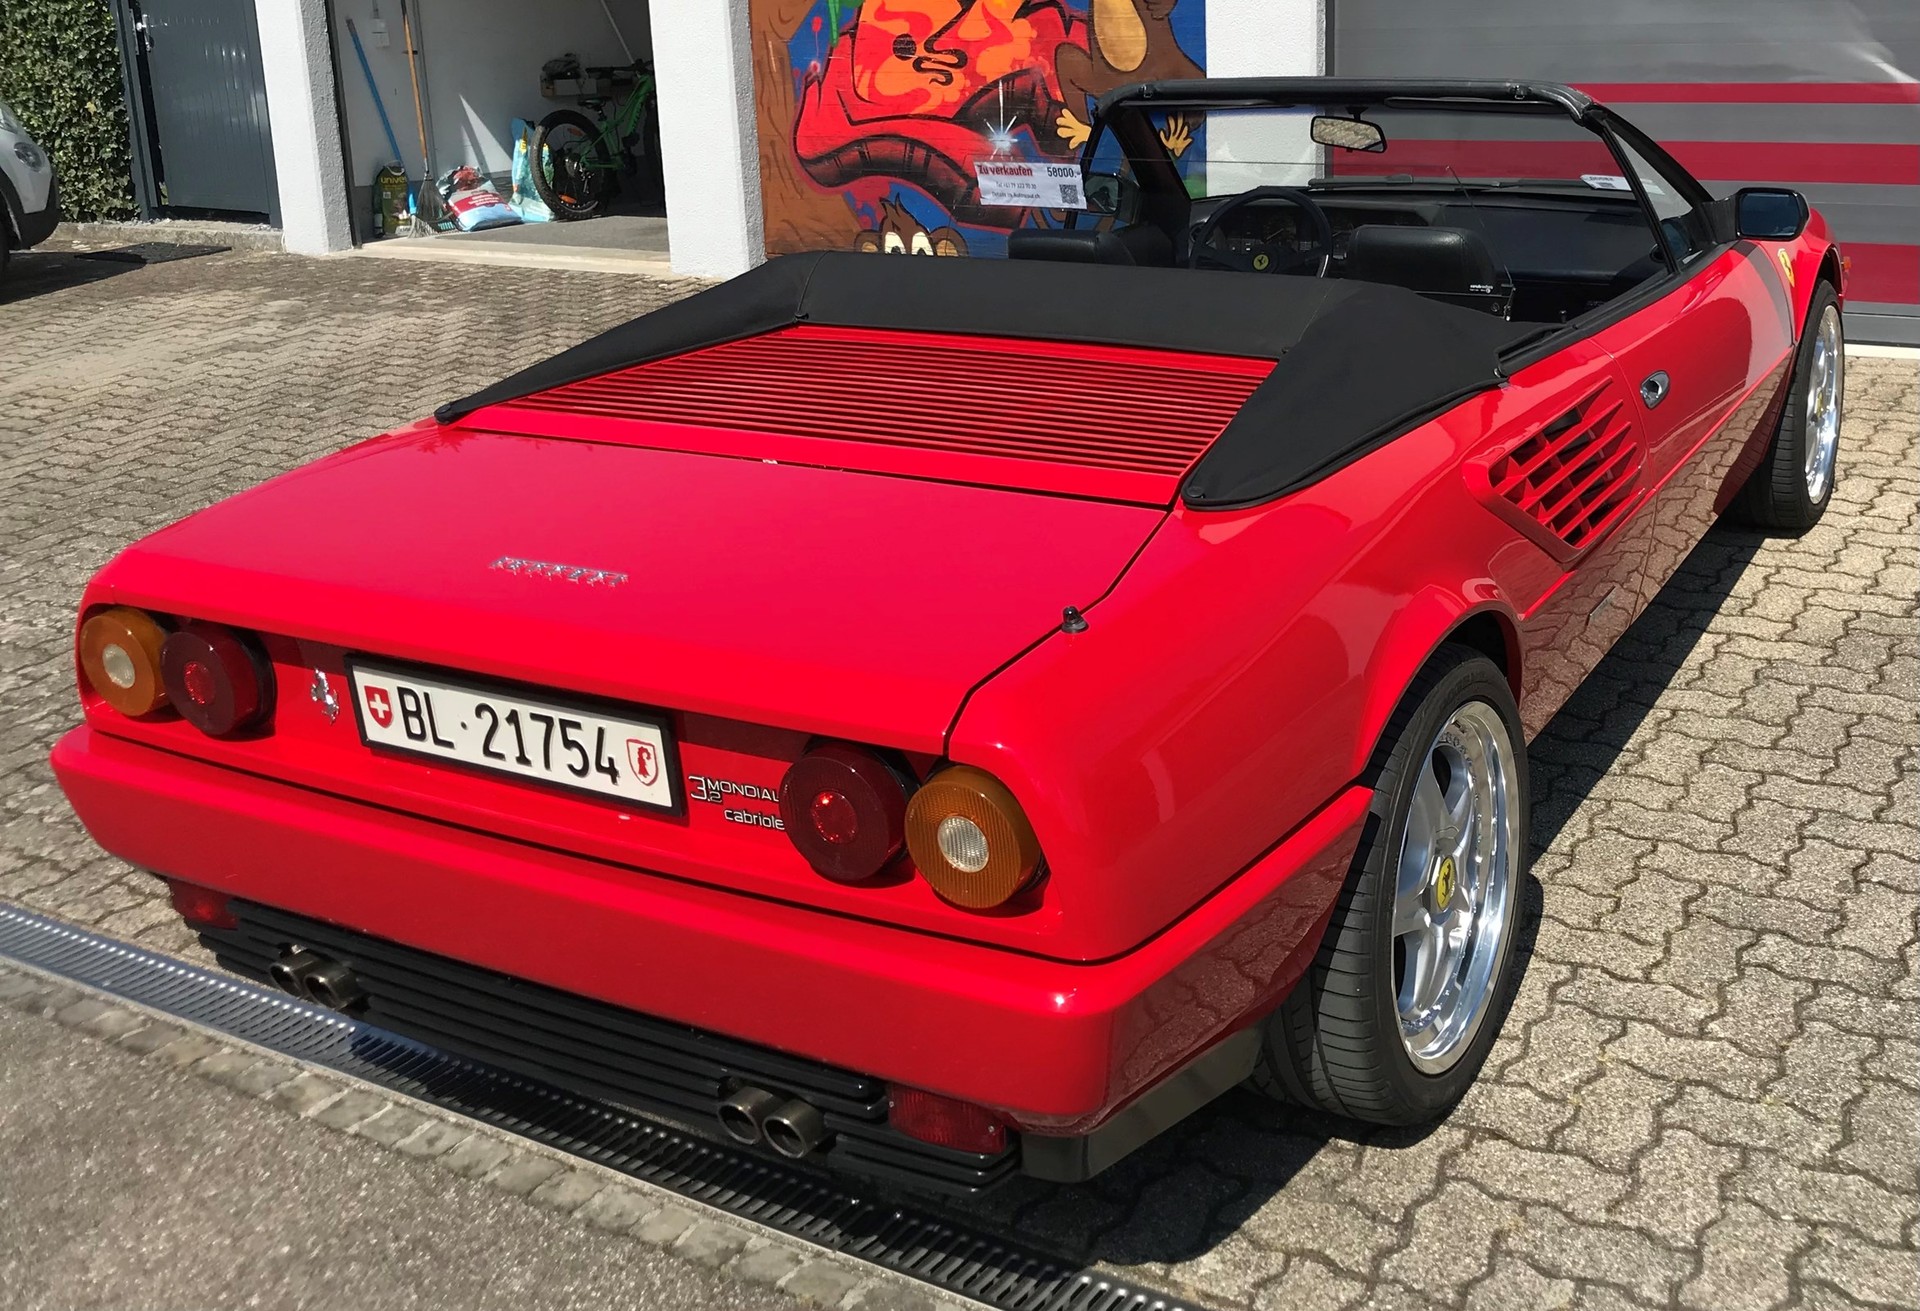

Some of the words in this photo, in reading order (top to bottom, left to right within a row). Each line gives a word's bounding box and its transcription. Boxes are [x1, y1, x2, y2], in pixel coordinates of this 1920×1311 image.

[977, 164, 989, 175] Zu
[989, 165, 1033, 177] verkaufen
[707, 779, 780, 802] MONDIAL
